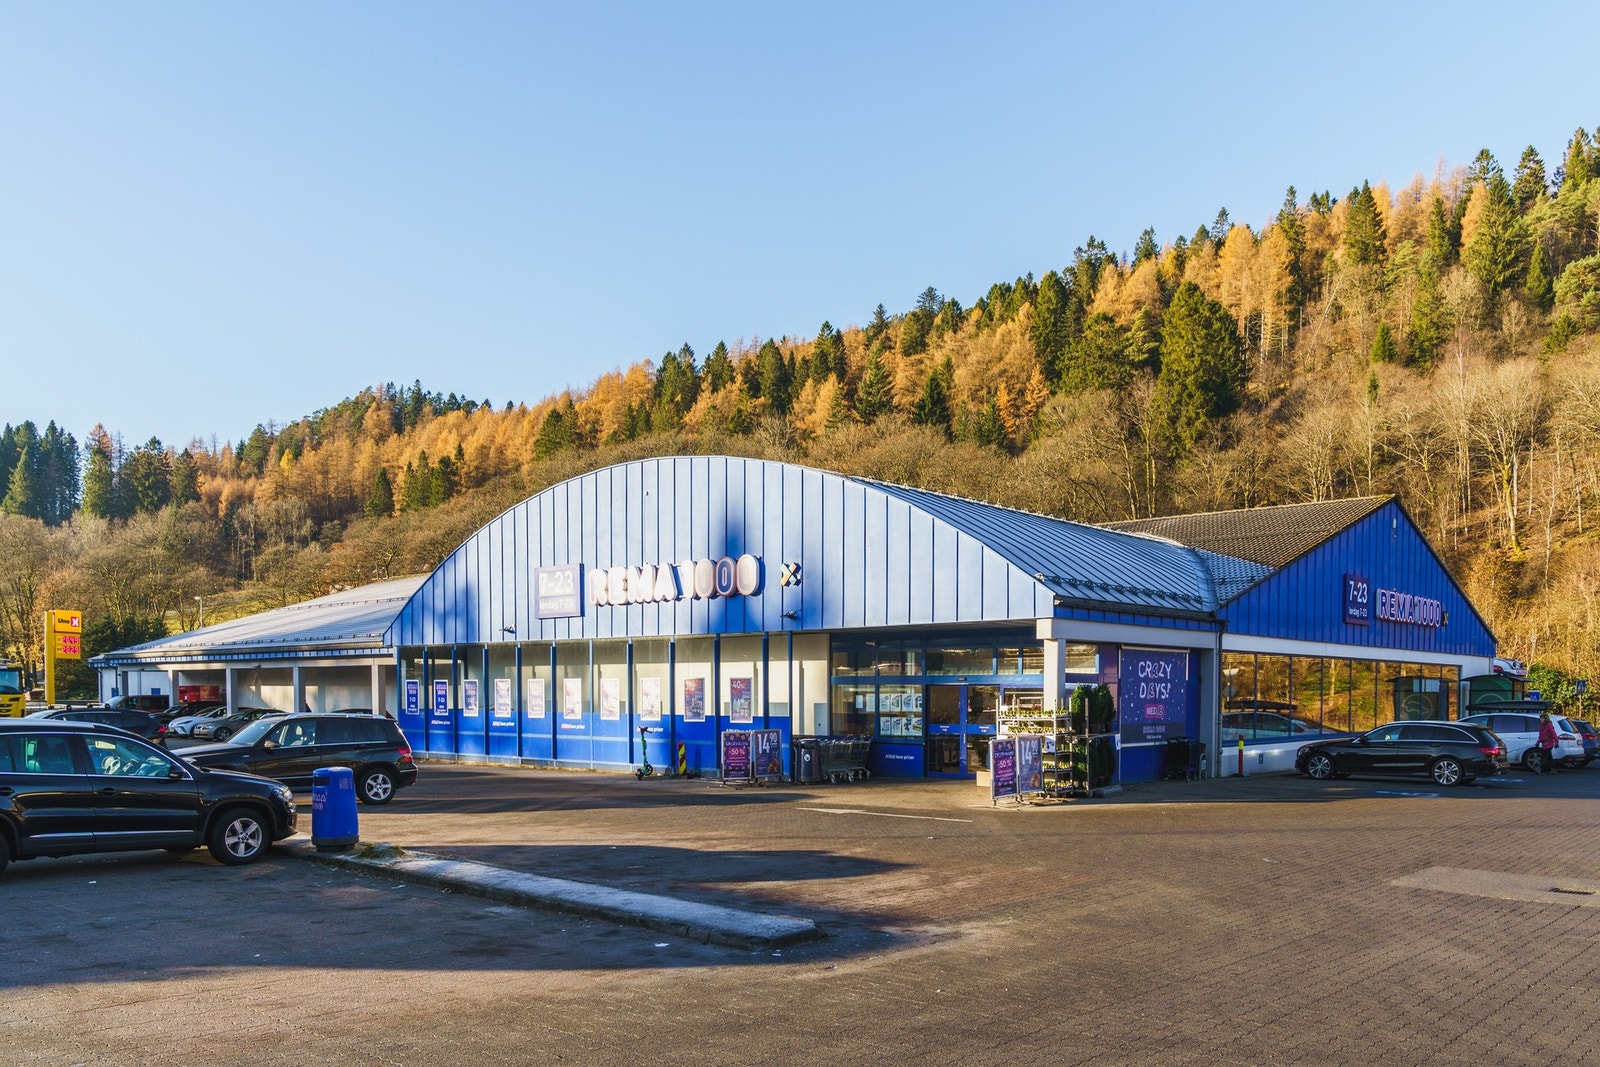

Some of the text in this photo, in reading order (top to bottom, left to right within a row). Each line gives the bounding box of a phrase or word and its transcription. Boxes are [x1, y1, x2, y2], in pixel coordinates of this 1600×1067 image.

[539, 570, 574, 595] 7-23
[588, 553, 759, 606] REMA 1000
[1349, 580, 1368, 604] 7-23
[1378, 588, 1441, 628] REMA 1000
[758, 734, 770, 754] 14
[1020, 740, 1032, 765] 14
